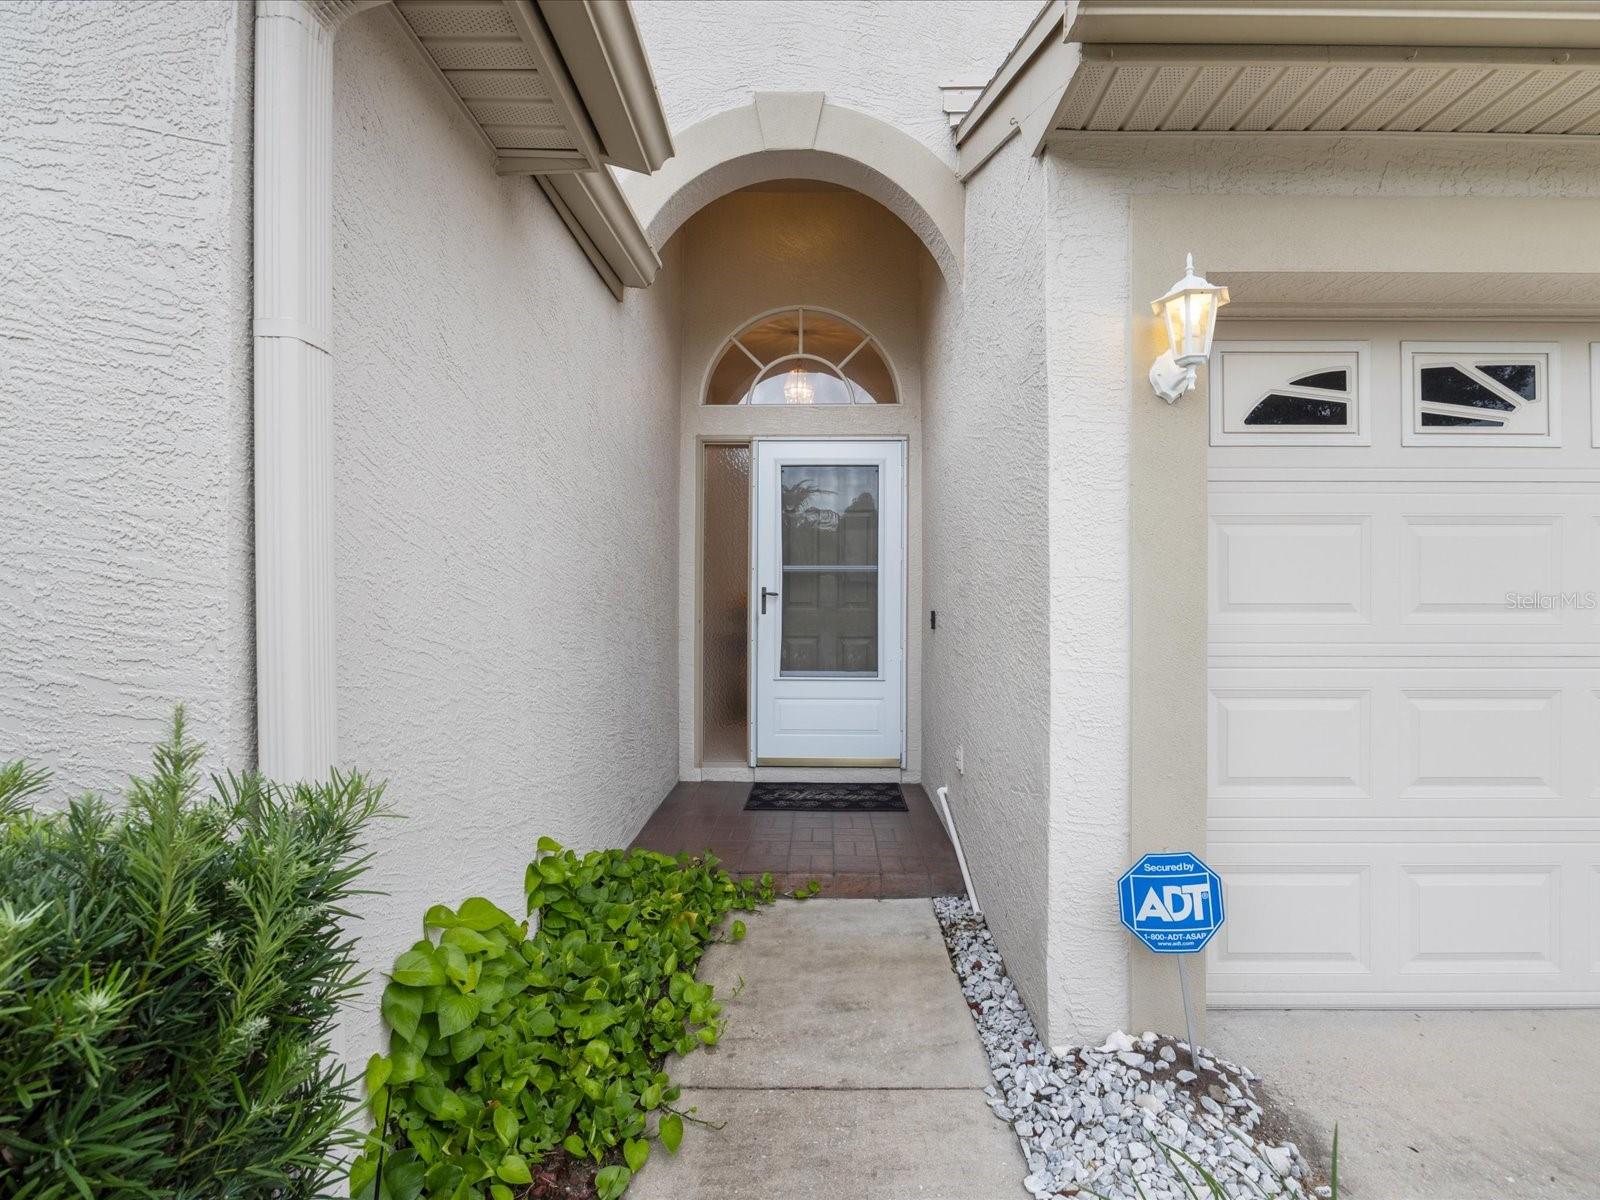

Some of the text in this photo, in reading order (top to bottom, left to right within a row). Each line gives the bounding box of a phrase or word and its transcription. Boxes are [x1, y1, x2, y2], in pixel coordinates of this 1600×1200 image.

[1144, 863, 1195, 872] Secured by
[1136, 883, 1209, 922] ADT
[1144, 932, 1207, 941] 1-800-ADT-ASAP
